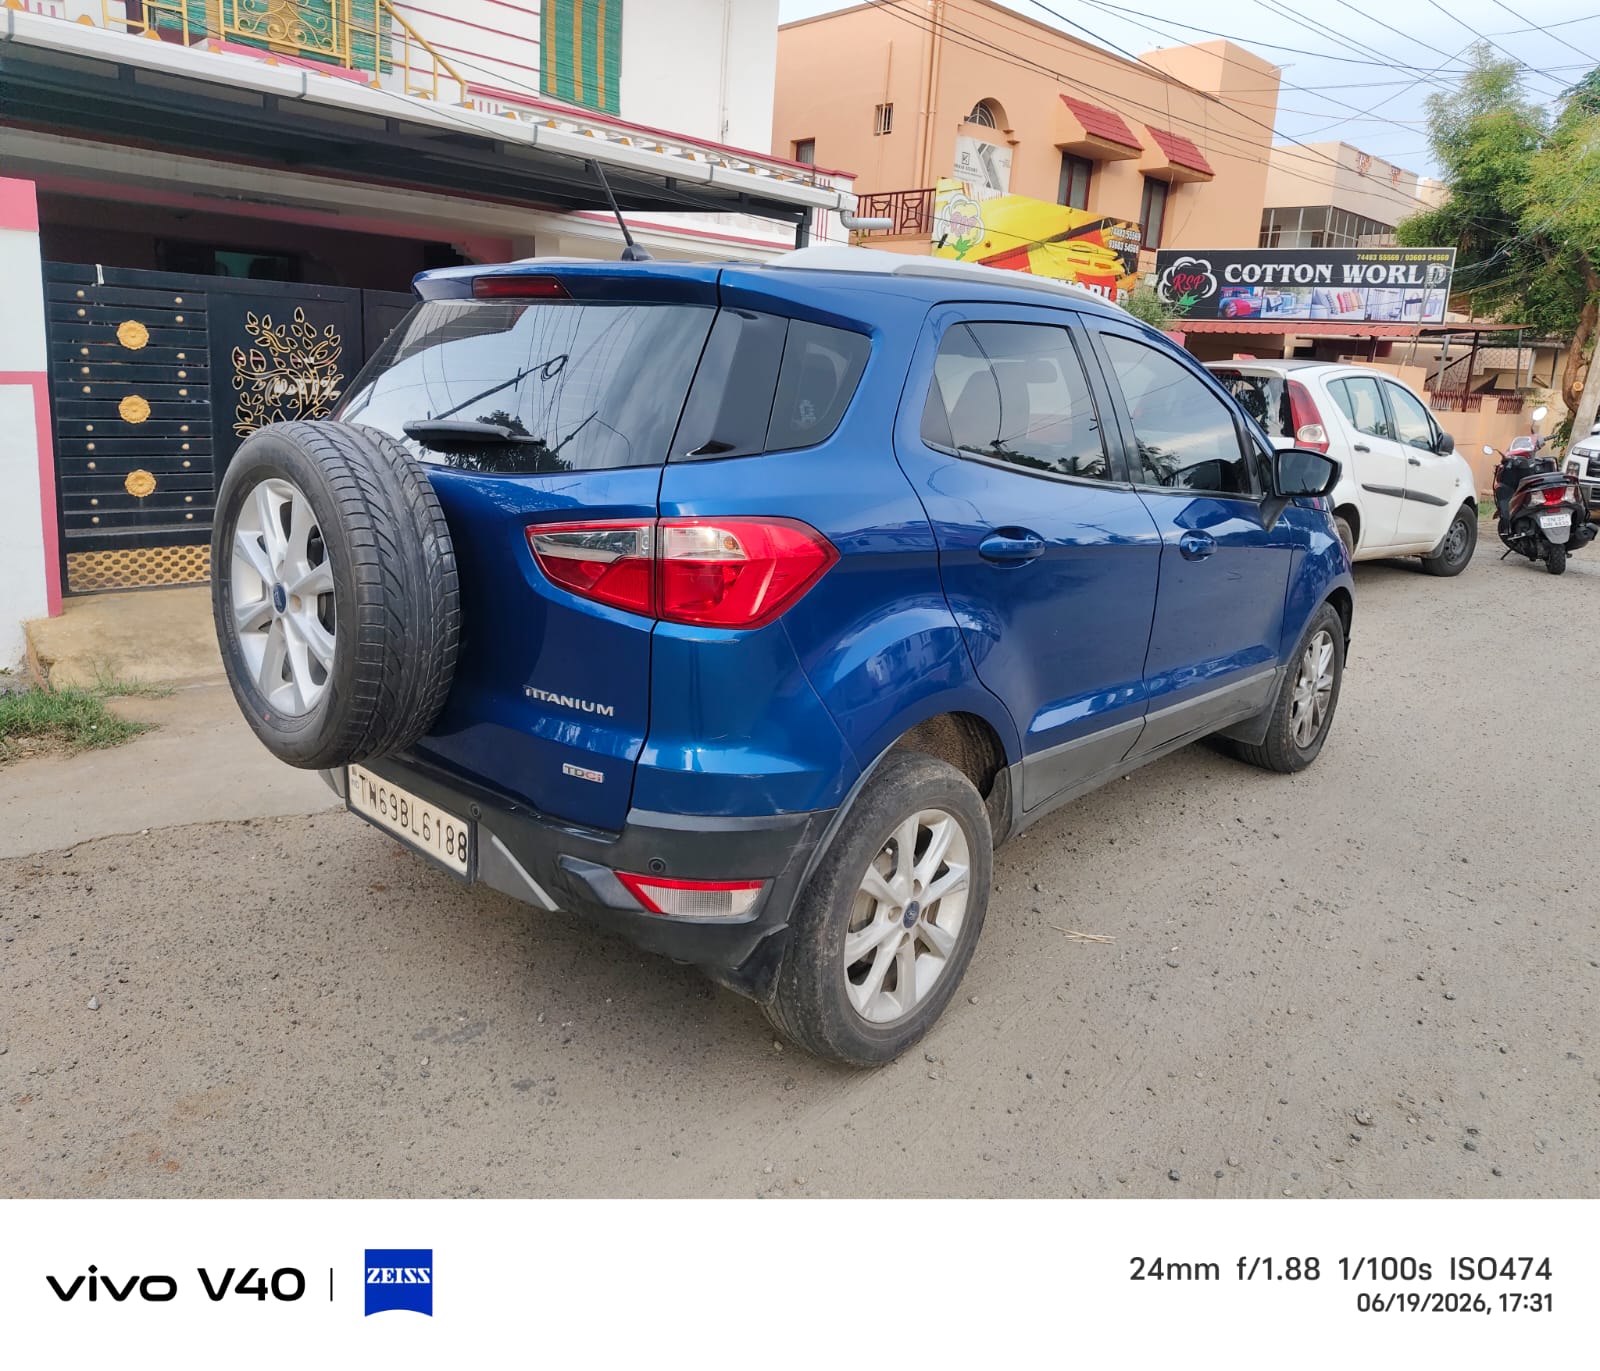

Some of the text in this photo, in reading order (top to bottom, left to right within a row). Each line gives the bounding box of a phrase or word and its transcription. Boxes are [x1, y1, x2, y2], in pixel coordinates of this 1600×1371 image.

[1224, 263, 1447, 285] COTTON WORLD
[523, 685, 614, 717] TITANIUM
[359, 774, 467, 864] TN69BL6188
